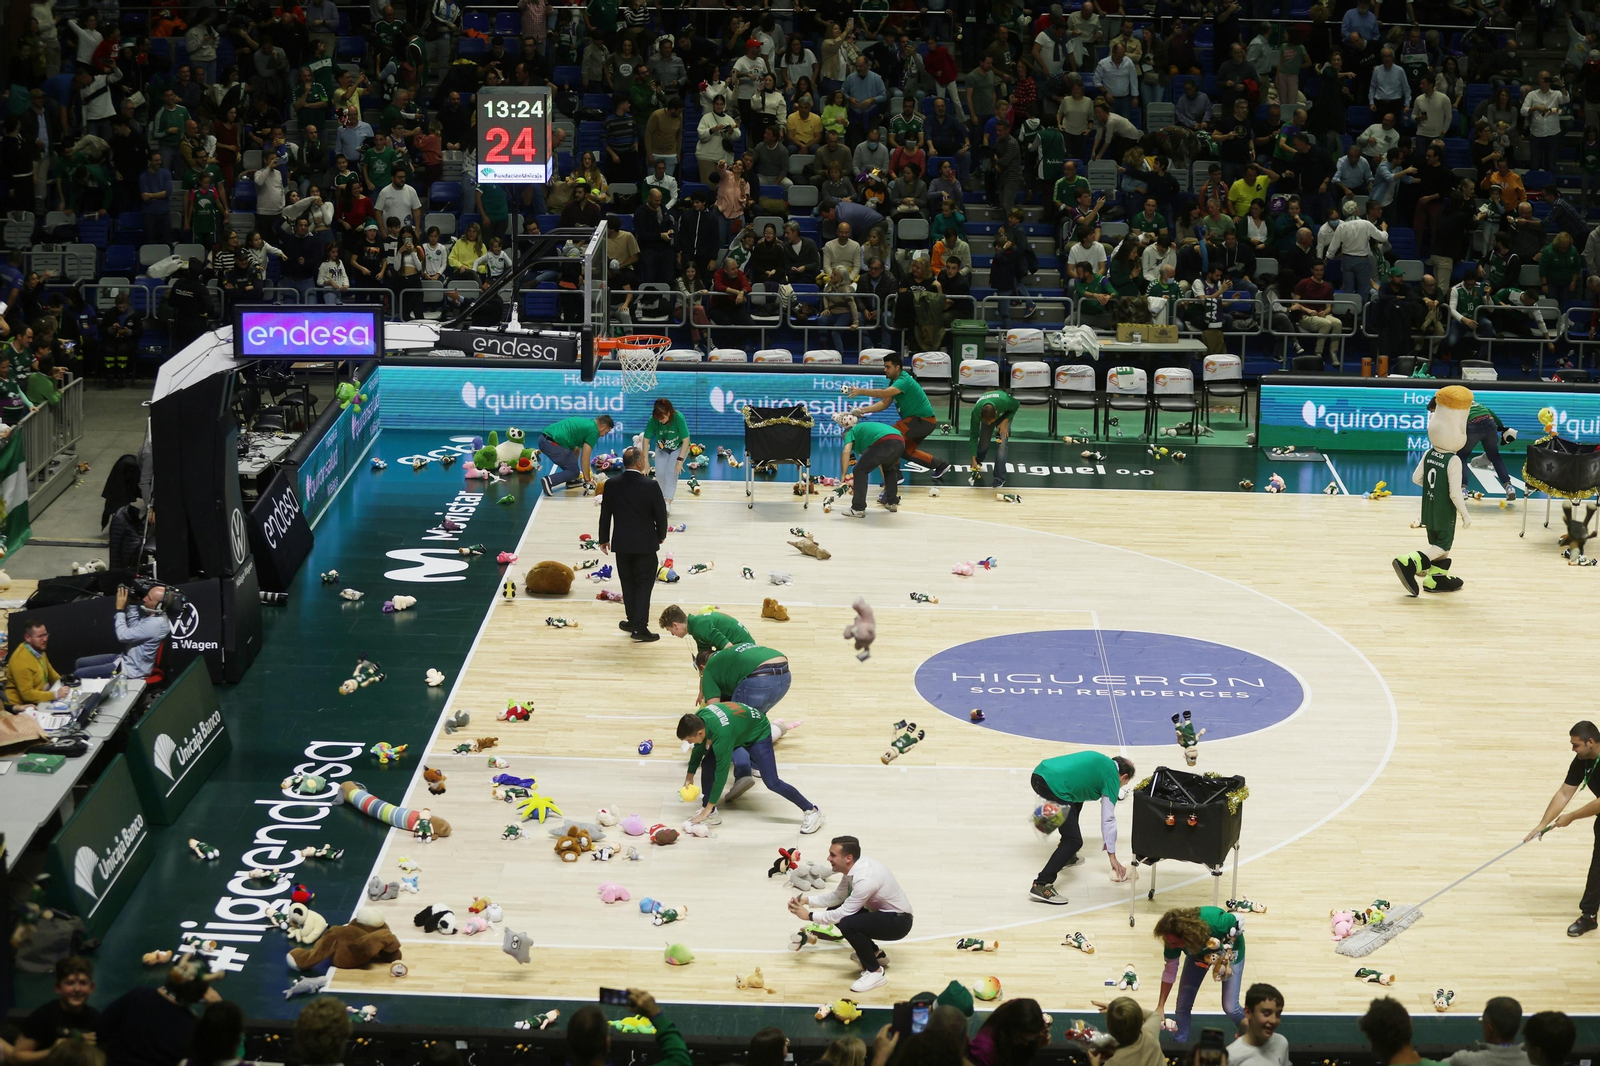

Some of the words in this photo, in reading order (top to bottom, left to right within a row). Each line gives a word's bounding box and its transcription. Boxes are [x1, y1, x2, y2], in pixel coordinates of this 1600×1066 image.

[484, 101, 543, 118] 13:24
[486, 127, 537, 162] 24
[248, 320, 369, 346] endesa
[473, 337, 558, 361] endesa
[485, 391, 624, 416] quirónsalud
[1428, 468, 1437, 489] 0
[263, 485, 300, 549] endesa
[180, 640, 218, 652] Wagen
[970, 686, 1063, 696] SOUTH
[1077, 688, 1250, 699] RESIDENCES
